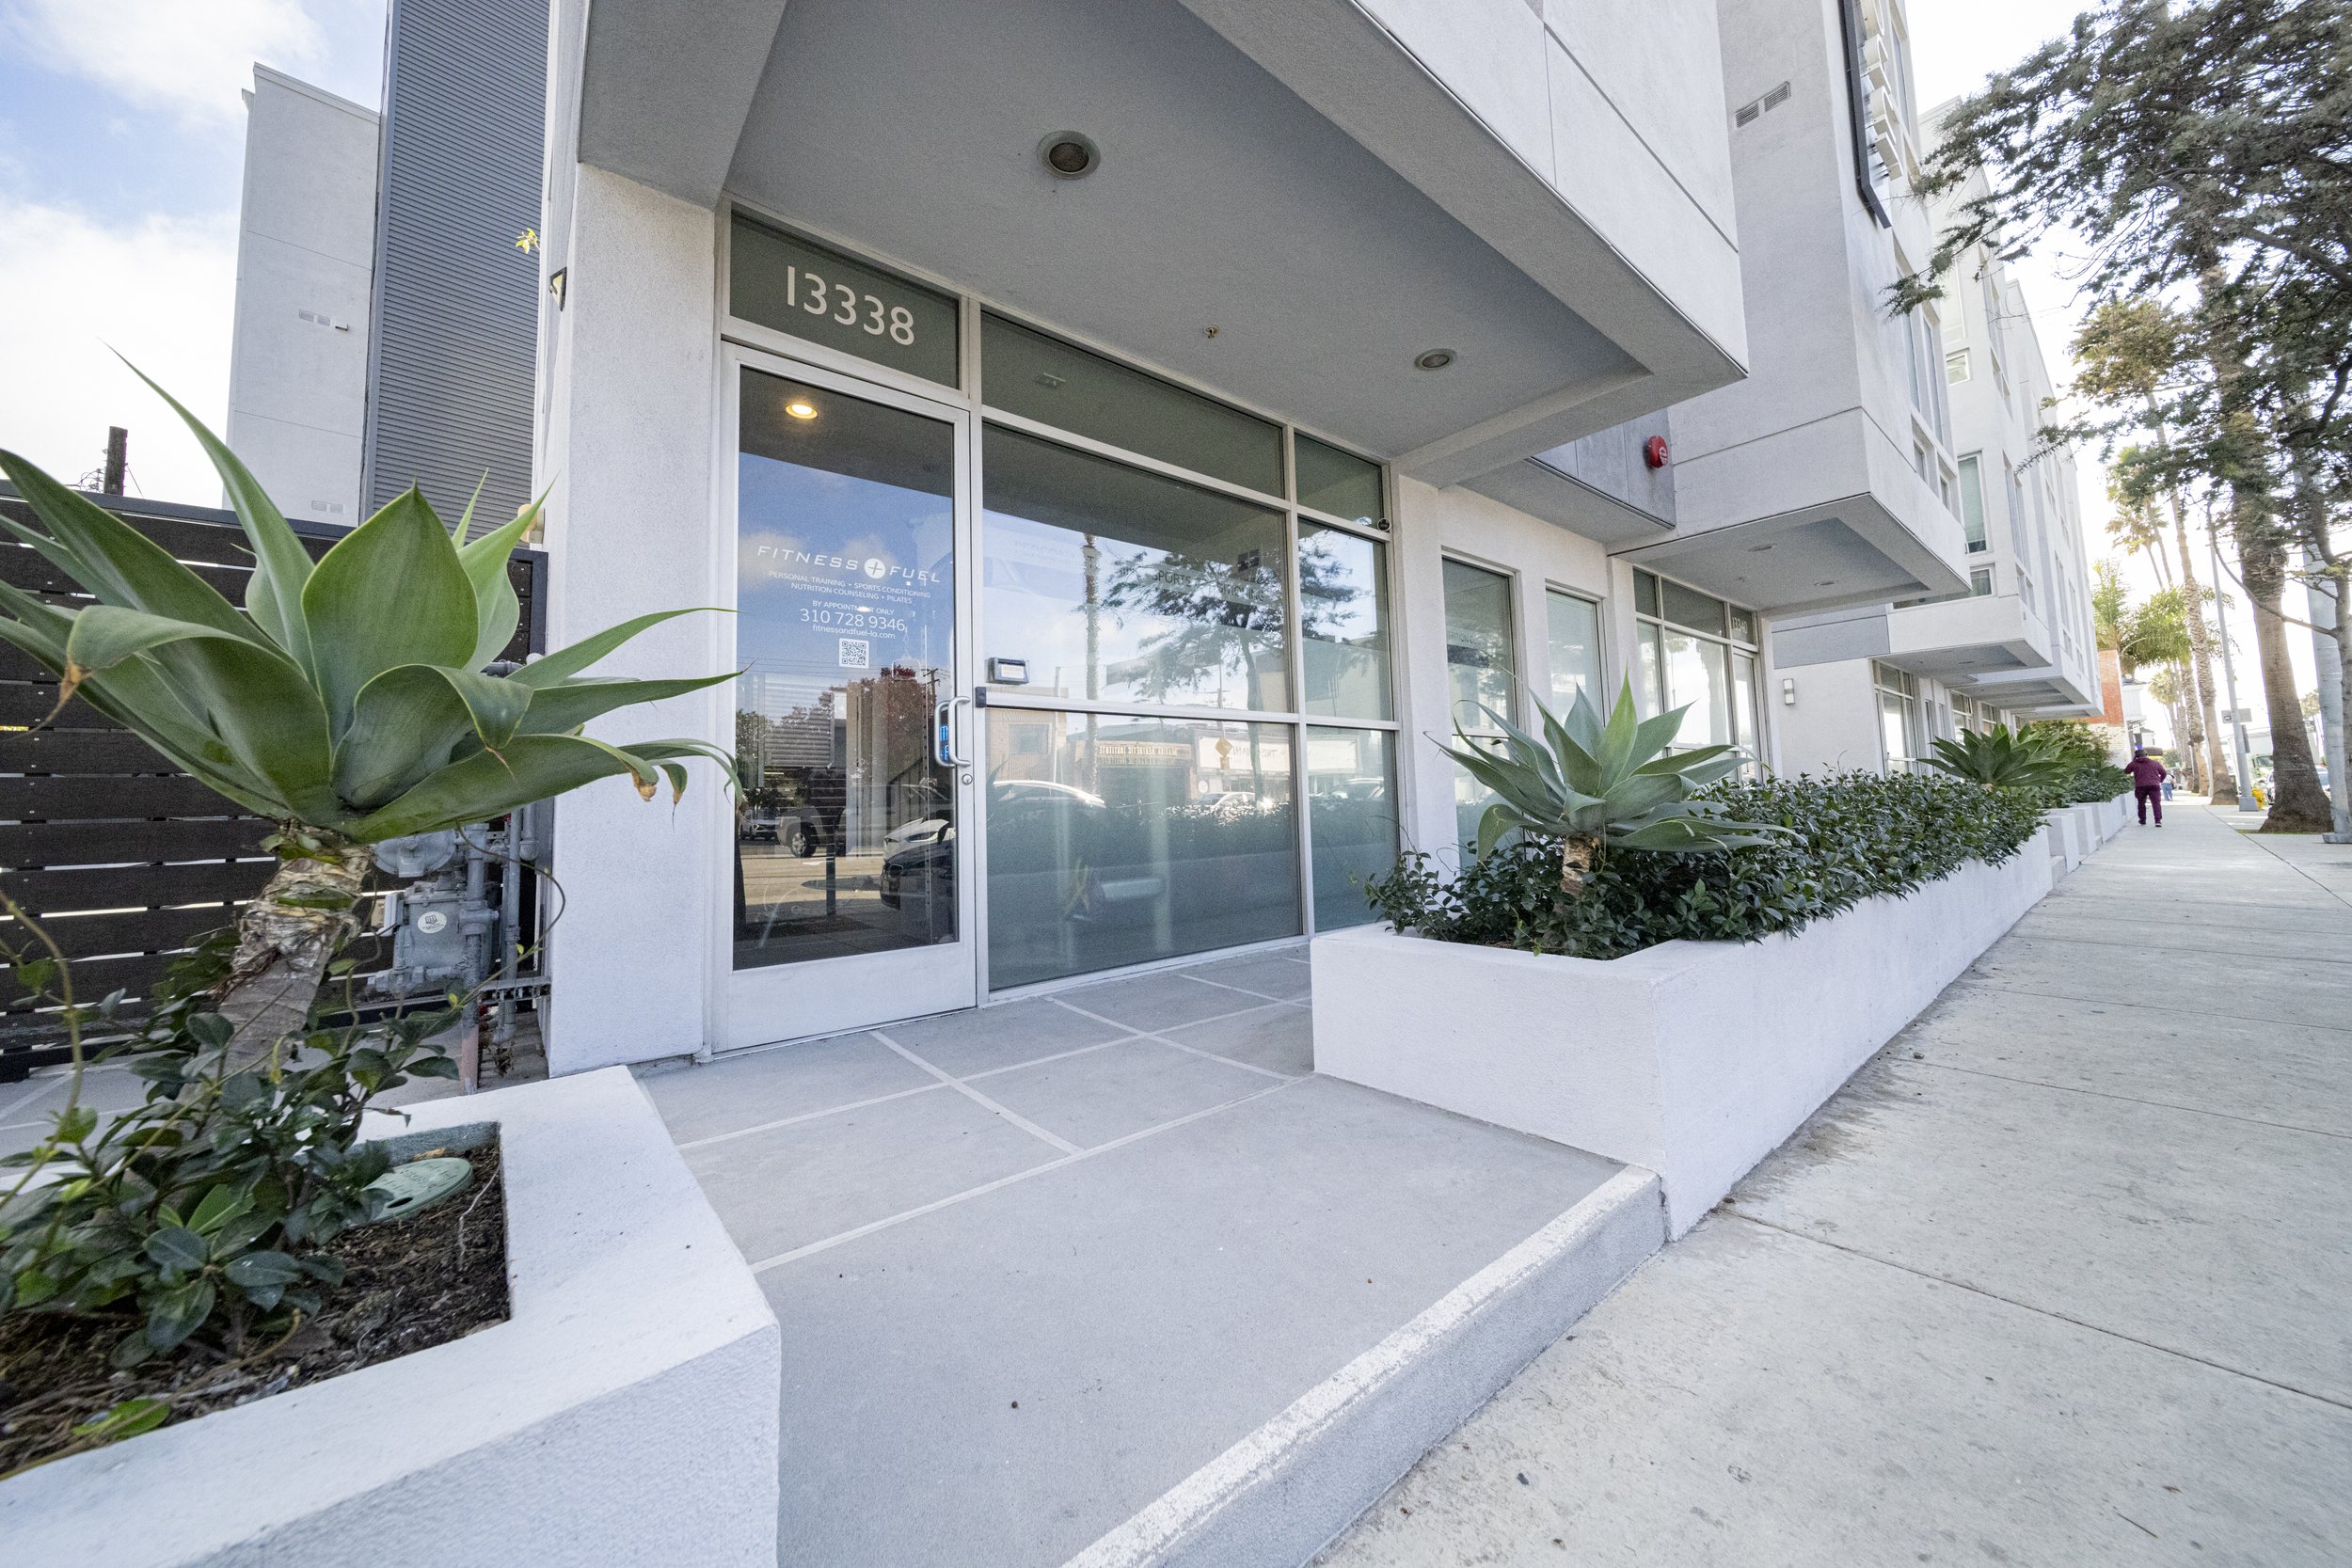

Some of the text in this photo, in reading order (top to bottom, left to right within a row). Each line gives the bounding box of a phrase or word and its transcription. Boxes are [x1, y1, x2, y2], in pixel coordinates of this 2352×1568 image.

[787, 265, 914, 345] 13338
[756, 546, 940, 582] FITNESS FUEL
[769, 570, 931, 598] PERSONAL TRAINING SPORTS CONDITIONING
[790, 582, 913, 604] NUTRITION COUNSELING PILATES
[800, 608, 905, 631] 310 728 9346
[823, 602, 875, 613] APPOINTT
[875, 608, 895, 616] ONLY
[812, 625, 896, 640] fitnessandfuel-la.com
